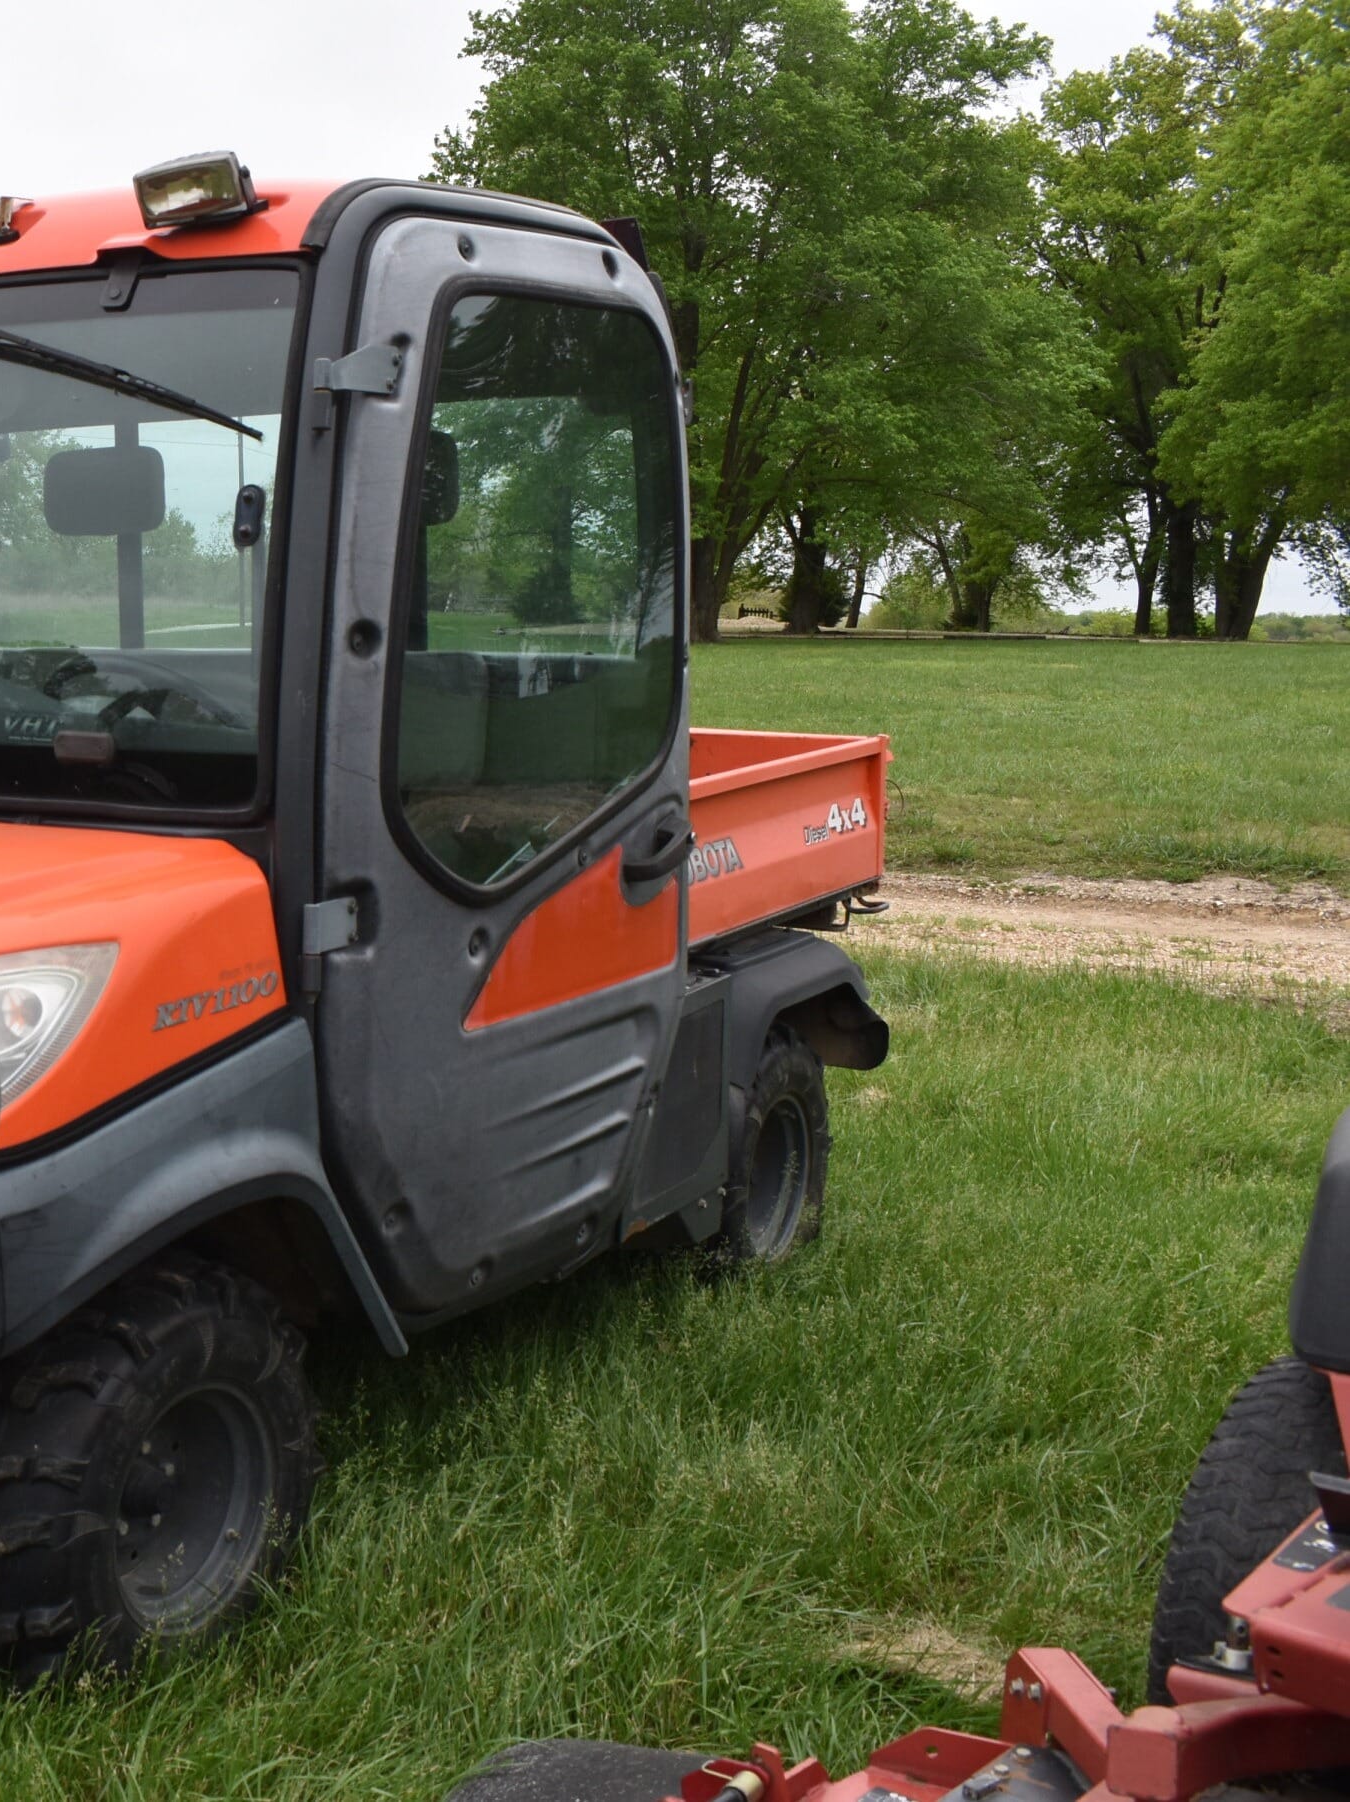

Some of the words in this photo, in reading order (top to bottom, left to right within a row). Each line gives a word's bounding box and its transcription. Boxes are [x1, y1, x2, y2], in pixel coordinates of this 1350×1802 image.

[828, 797, 867, 834] 4x4
[687, 836, 744, 886] BOTA
[152, 970, 279, 1032] RTV1100
